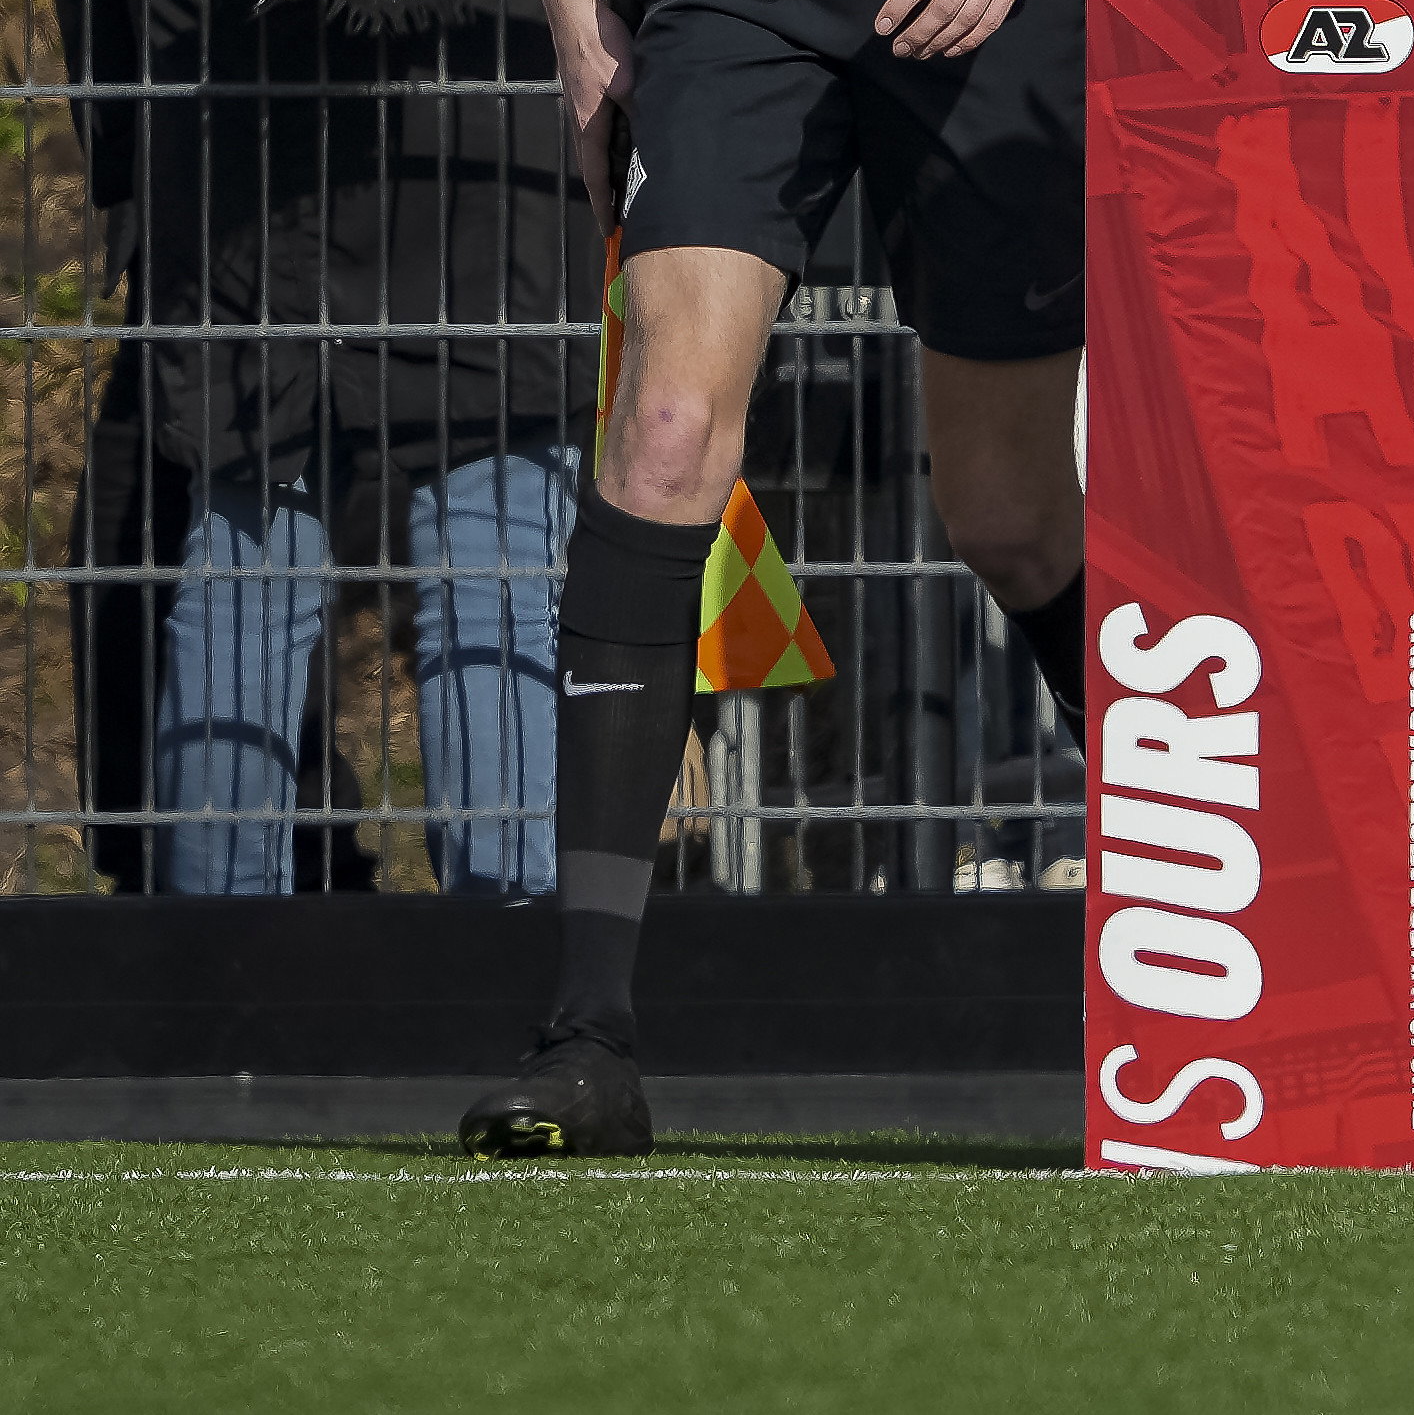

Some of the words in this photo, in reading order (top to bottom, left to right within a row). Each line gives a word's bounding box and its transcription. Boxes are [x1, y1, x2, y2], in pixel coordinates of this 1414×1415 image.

[1286, 6, 1391, 64] AZ
[1099, 601, 1264, 1022] OURS
[1099, 1043, 1264, 1176] IS
